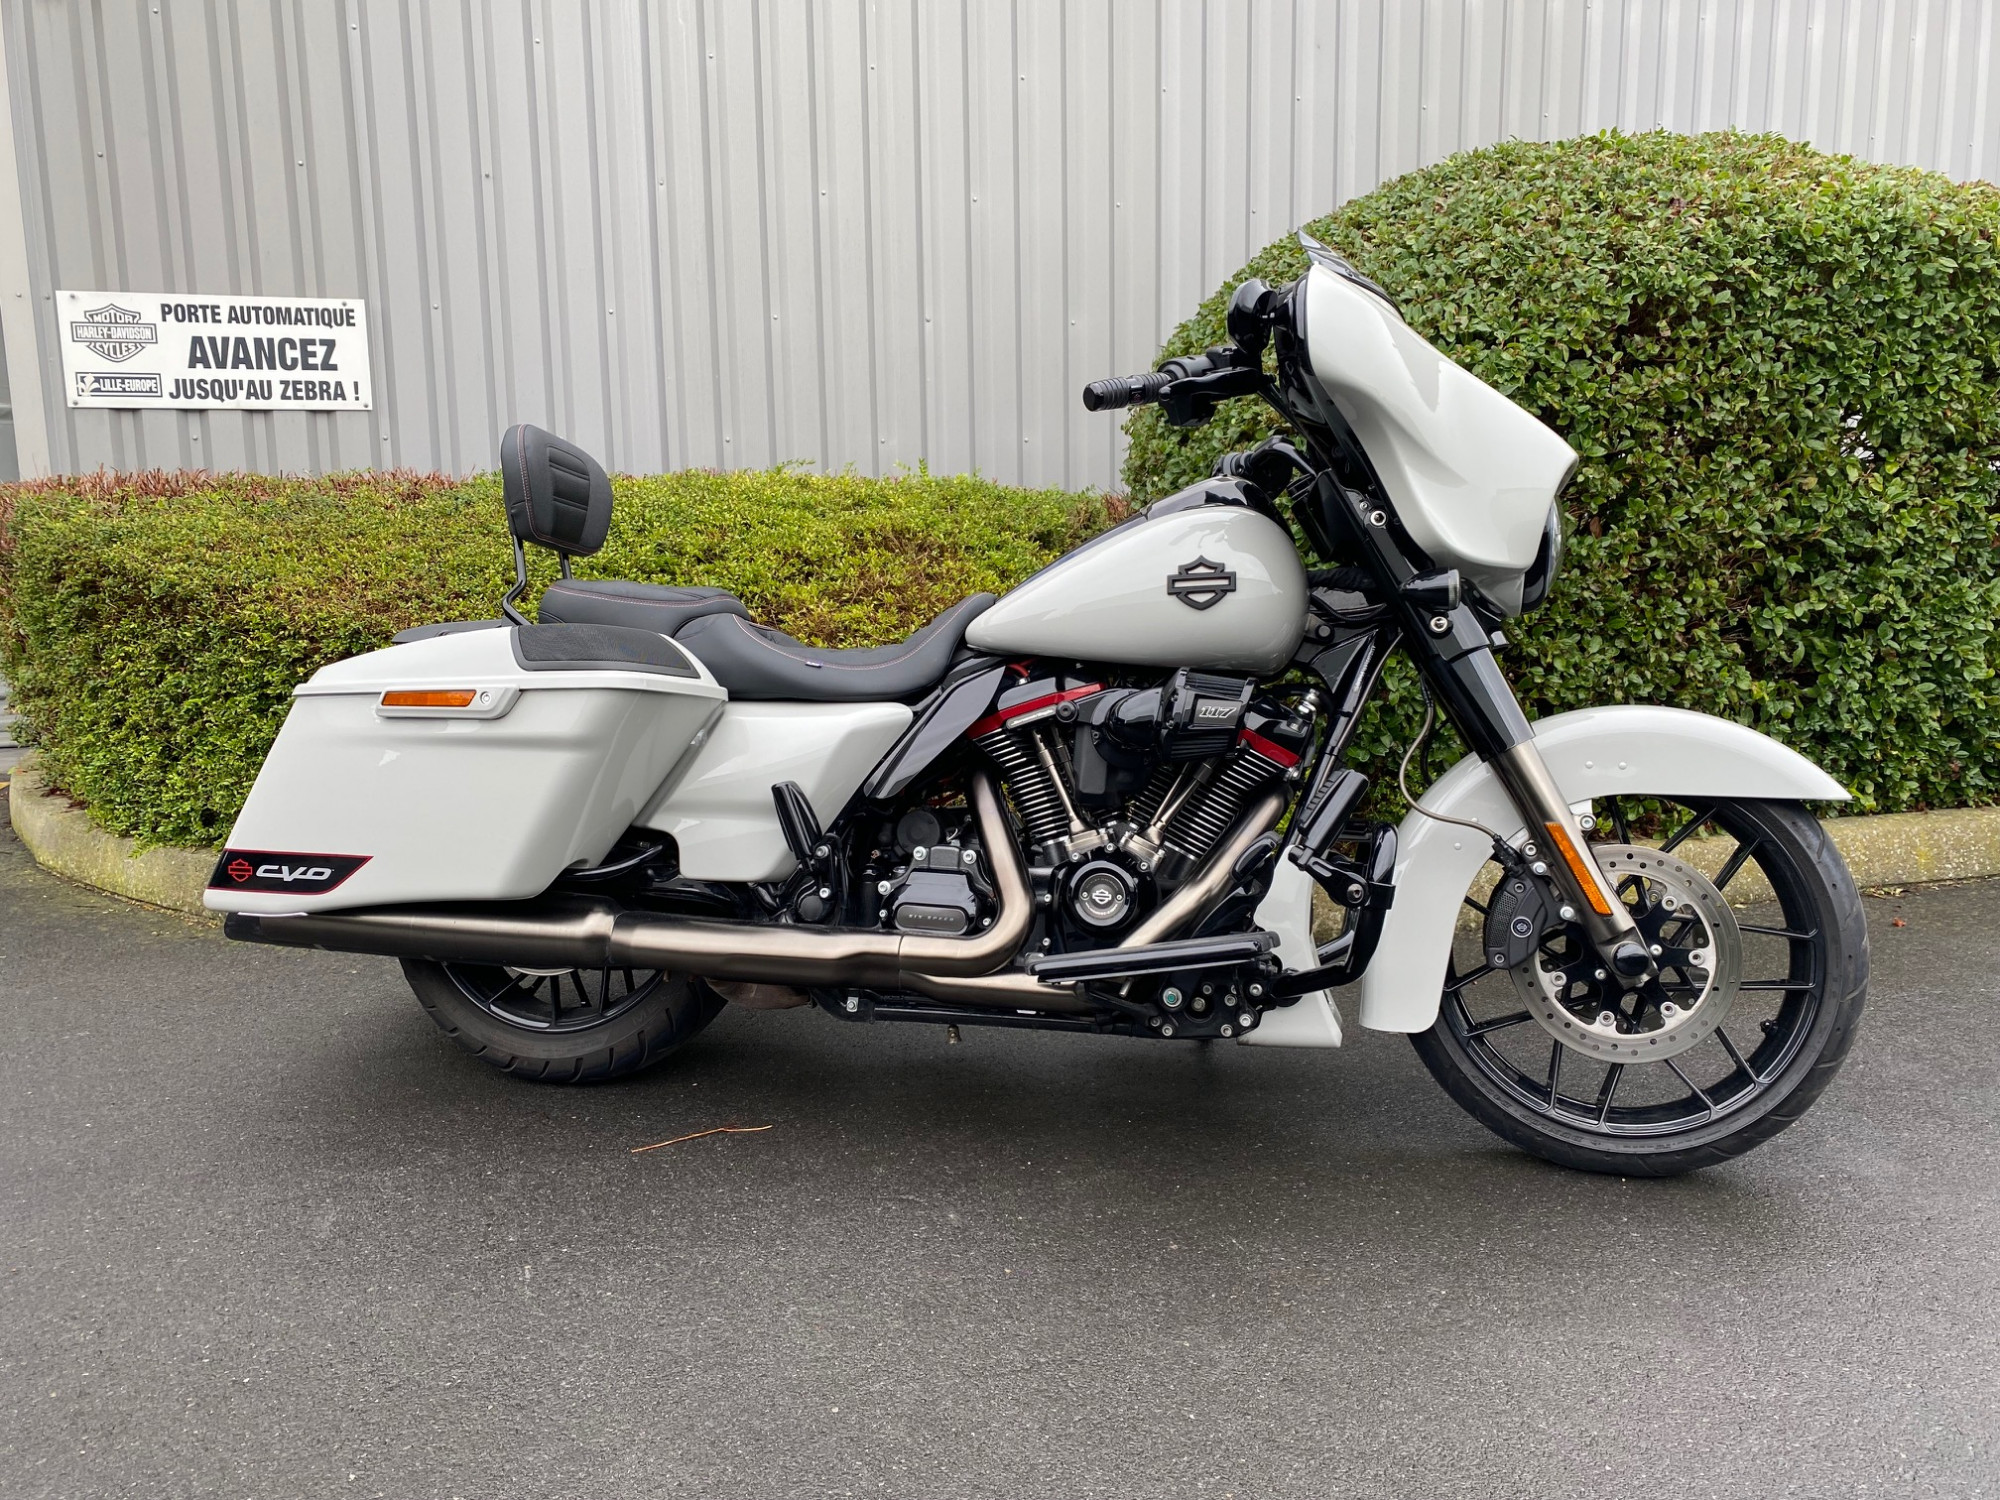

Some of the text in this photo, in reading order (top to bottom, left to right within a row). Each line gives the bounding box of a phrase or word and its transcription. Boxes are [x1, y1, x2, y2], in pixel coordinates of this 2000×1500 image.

[92, 310, 134, 324] MOTOR
[161, 303, 356, 329] PORTE AUTOMATIQUE
[76, 325, 152, 340] HARLEY-DAVIDSON
[95, 342, 136, 359] CYCLES
[187, 335, 338, 371] AVANCEZ
[99, 378, 158, 392] LILLE-EUROPE
[168, 378, 273, 403] JUSQU'AU
[279, 380, 347, 401] ZEBRA
[1198, 705, 1237, 719] 117
[255, 864, 332, 882] CVO
